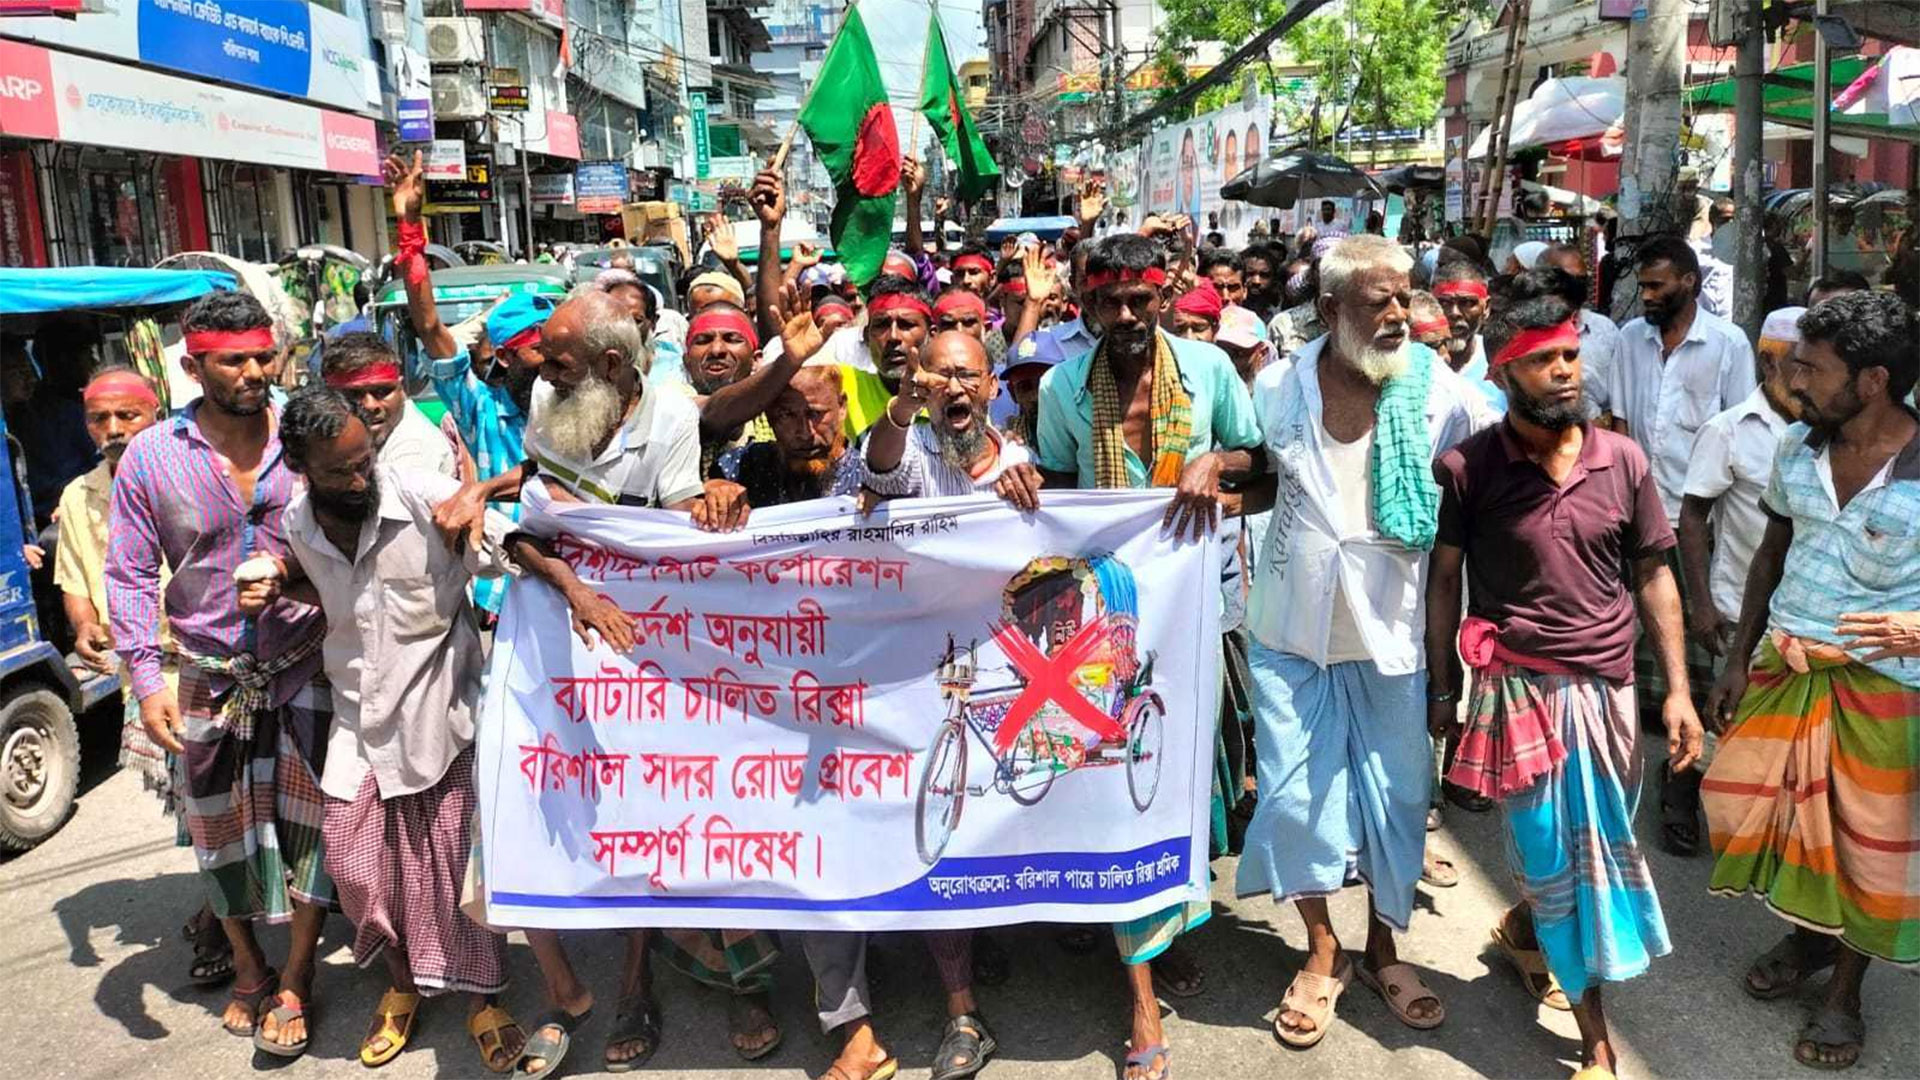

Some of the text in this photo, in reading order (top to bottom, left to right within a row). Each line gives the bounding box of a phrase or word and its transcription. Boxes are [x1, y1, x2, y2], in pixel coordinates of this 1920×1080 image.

[703, 597, 831, 669] অনুযায়ী
[551, 659, 869, 730] ব্যাটারি চালিত রিক্সা
[518, 732, 917, 802] বরিশাল সদর রোড প্রবেশ
[588, 813, 697, 893] সম্পূর্ণ
[700, 814, 806, 881] নিষেধ
[1013, 866, 1061, 891] বরিশাল
[1064, 869, 1095, 889] পায়ে
[1097, 864, 1134, 889] চালিত
[1156, 851, 1181, 877] শ্রমিক
